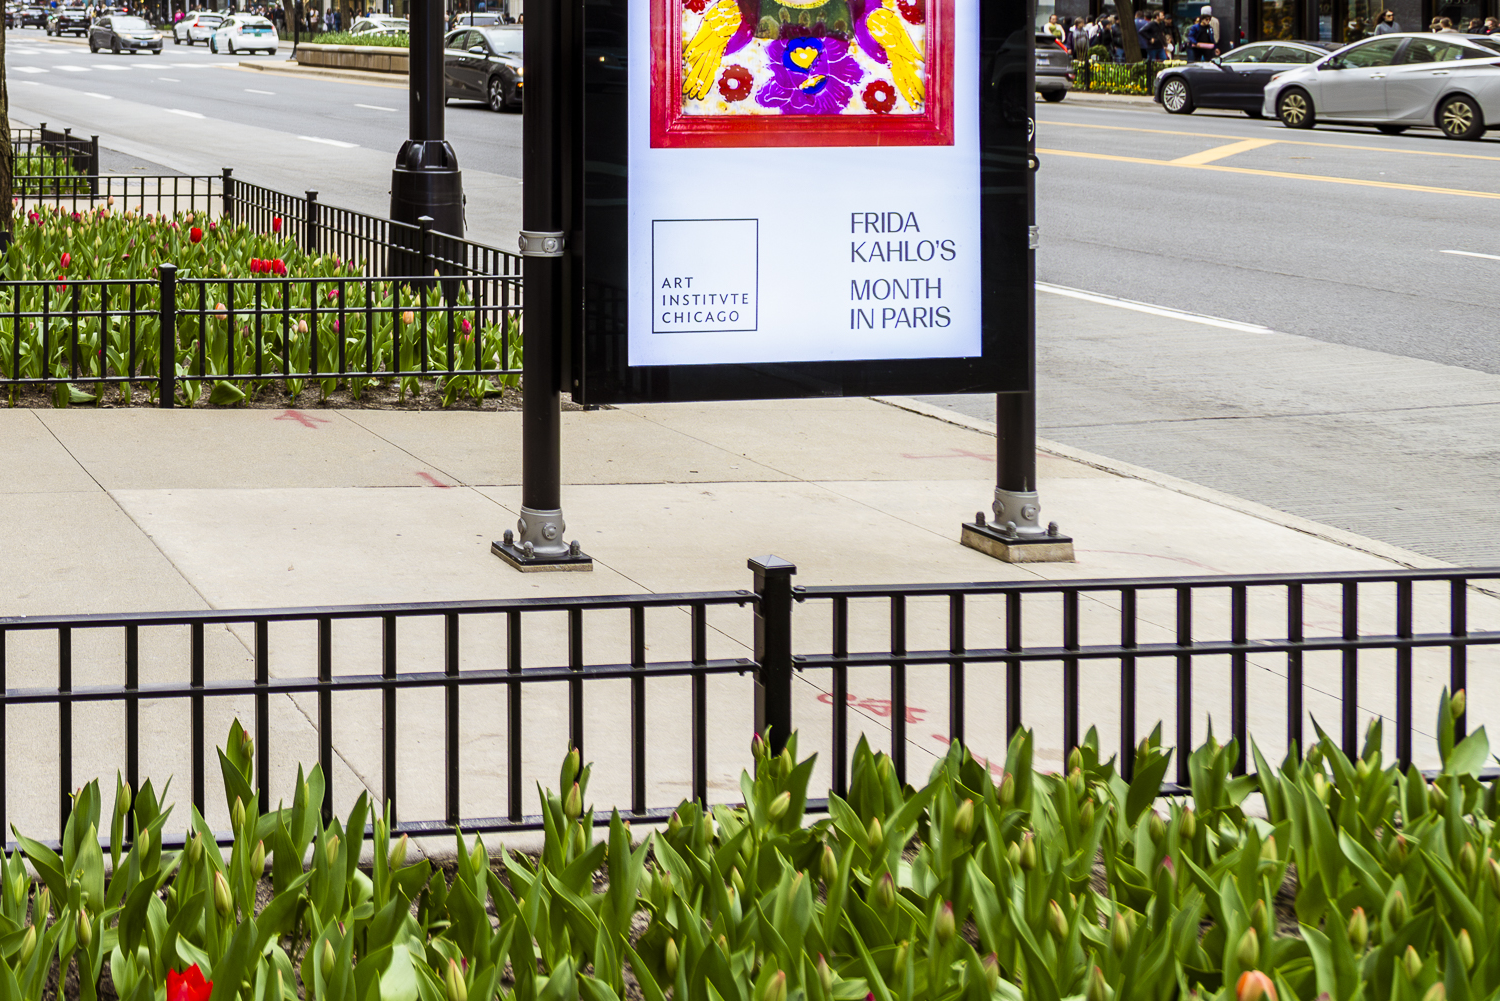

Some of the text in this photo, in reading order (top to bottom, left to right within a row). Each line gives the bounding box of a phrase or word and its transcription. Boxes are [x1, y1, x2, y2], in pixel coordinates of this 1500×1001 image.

[850, 211, 921, 234] FRIDA
[850, 239, 957, 263] KAHLO'S
[661, 277, 694, 289] ART
[850, 278, 942, 301] MONTH
[662, 293, 749, 307] INSTITVTE
[661, 310, 740, 324] CHICAGO
[850, 306, 951, 330] IN PARIS
